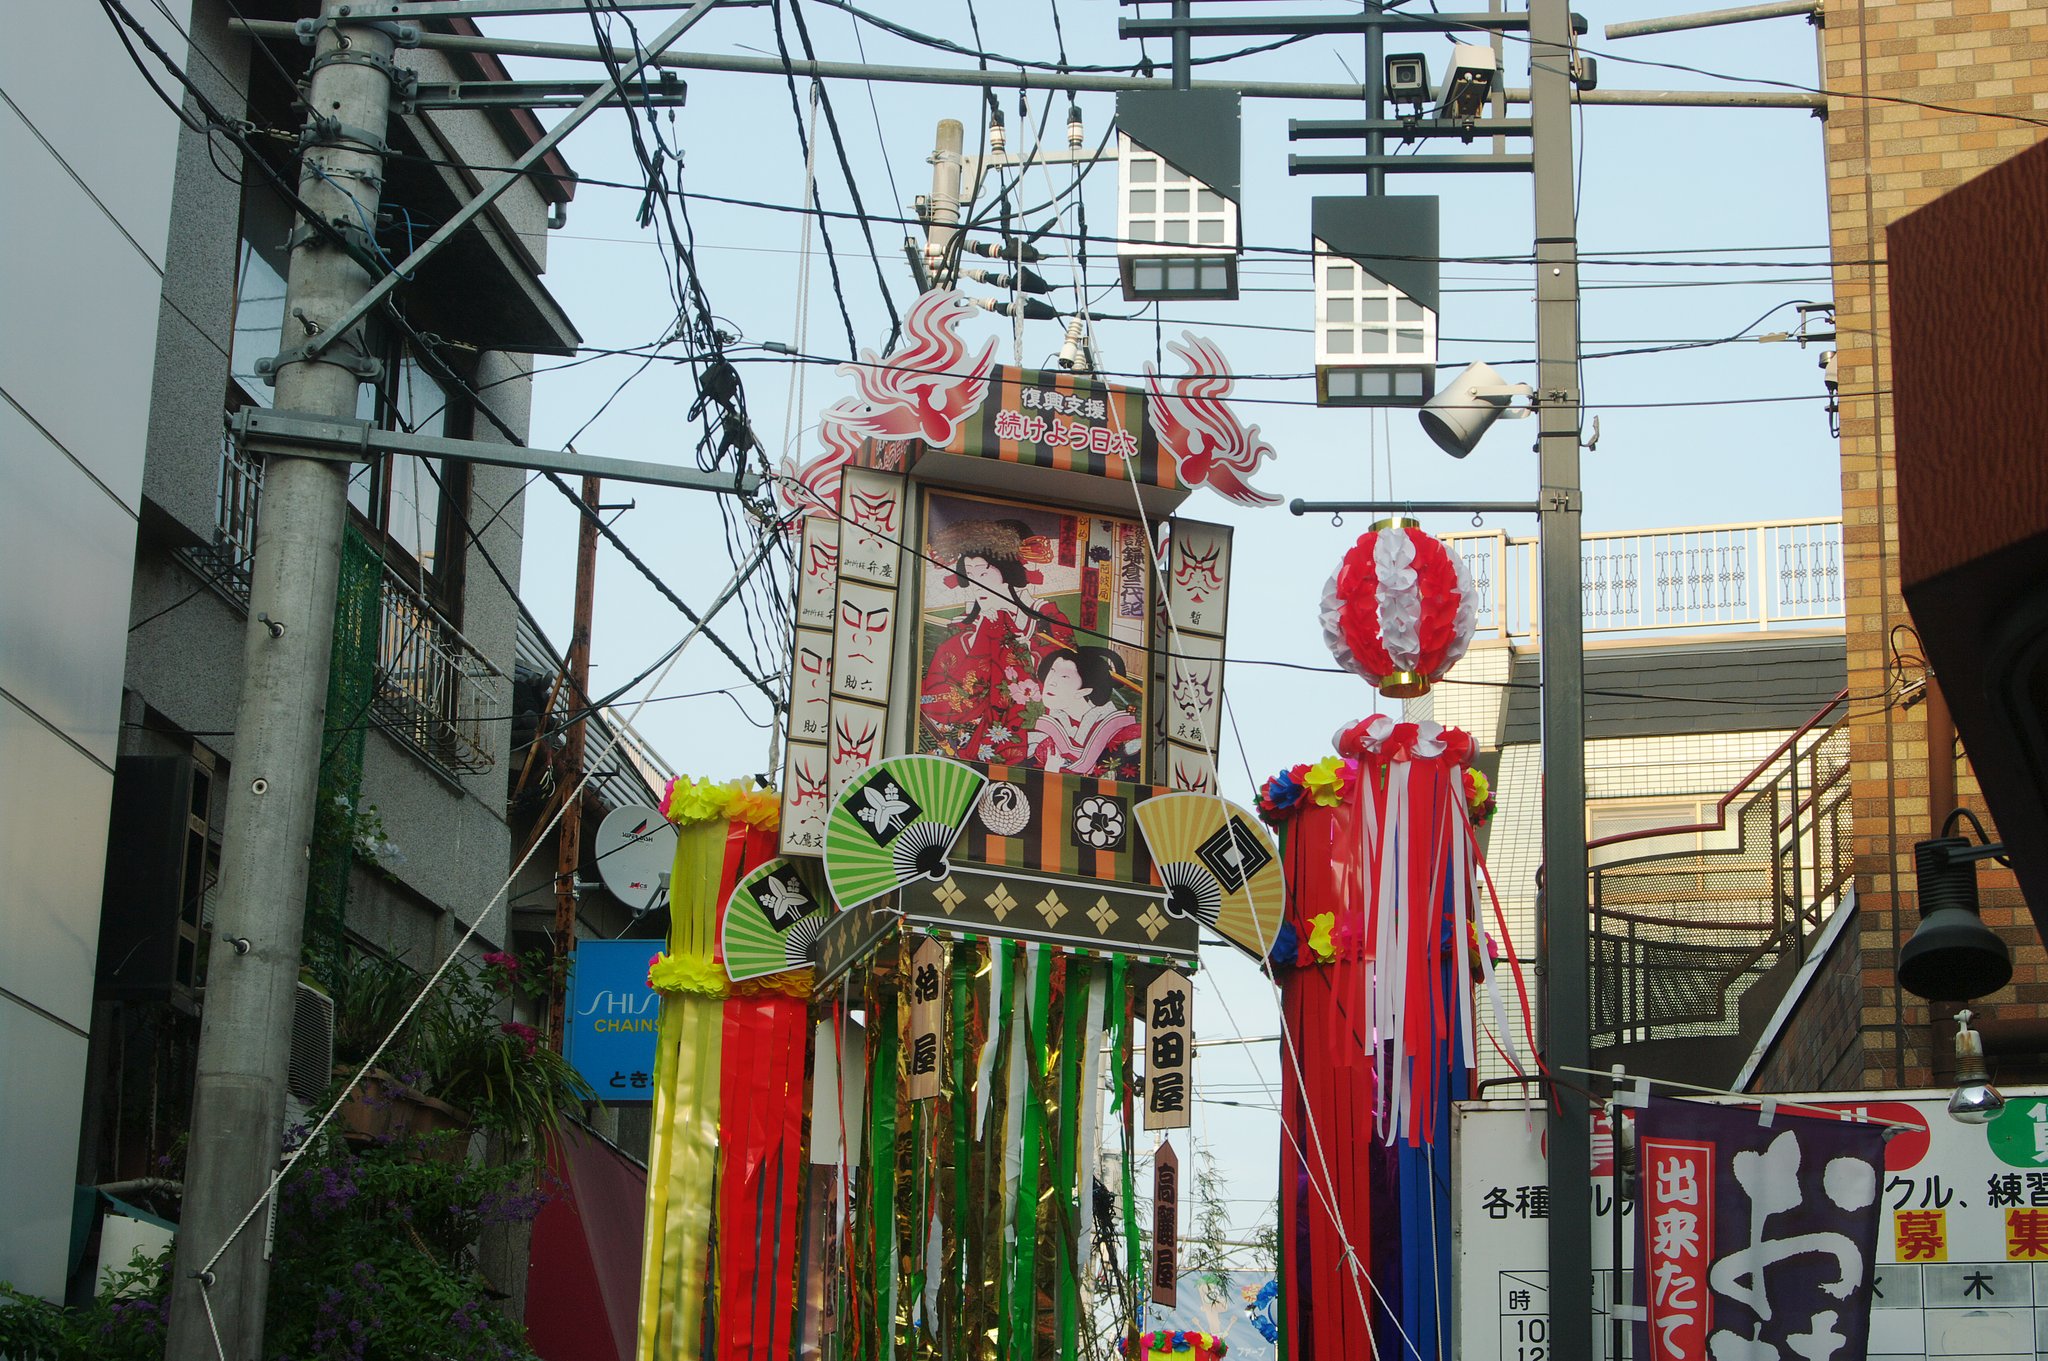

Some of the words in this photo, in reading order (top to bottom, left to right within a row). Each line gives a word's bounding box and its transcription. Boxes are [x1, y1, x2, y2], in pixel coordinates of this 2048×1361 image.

[1021, 387, 1107, 421] 復興支援
[994, 408, 1139, 459] 続けよう日本
[844, 674, 873, 692] 助六
[576, 990, 662, 1016] SHIS
[1149, 989, 1187, 1115] 成田屋
[609, 1070, 654, 1088] とき
[1653, 1156, 1699, 1360] 出来たて
[1962, 1270, 1995, 1300] 木
[1509, 1289, 1531, 1311] 時
[1517, 1319, 1549, 1344] 10
[1517, 1346, 1549, 1361] 12
